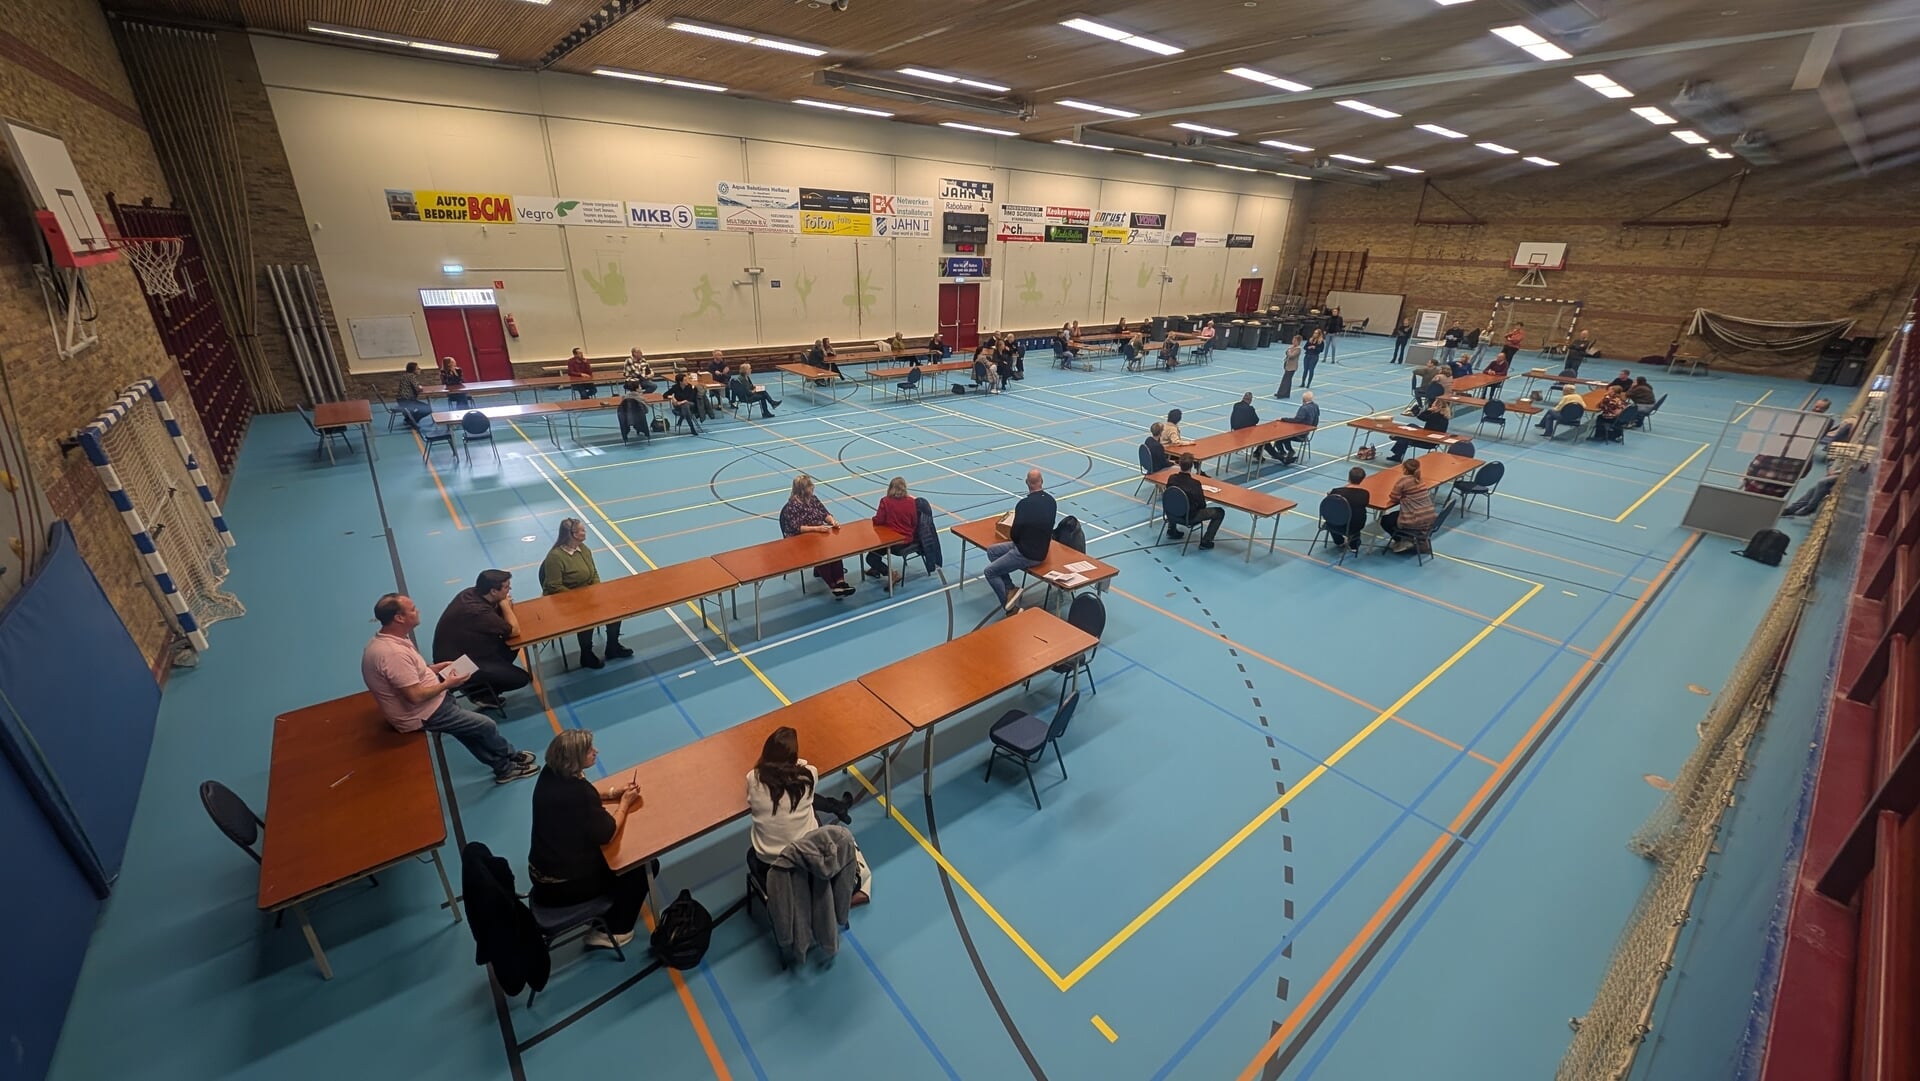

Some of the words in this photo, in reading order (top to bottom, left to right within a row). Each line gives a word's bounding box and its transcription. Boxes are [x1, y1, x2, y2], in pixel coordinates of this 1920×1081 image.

[942, 186, 976, 199] JAHN
[436, 195, 467, 207] AUTO
[945, 201, 973, 210] Rabobank
[423, 208, 468, 220] BEDRIJF
[467, 196, 513, 222] BCM
[517, 207, 554, 222] Vegro
[897, 207, 933, 217] installateurs
[1046, 206, 1067, 216] Keuken
[631, 208, 672, 223] MKB
[891, 217, 920, 231] JAHN
